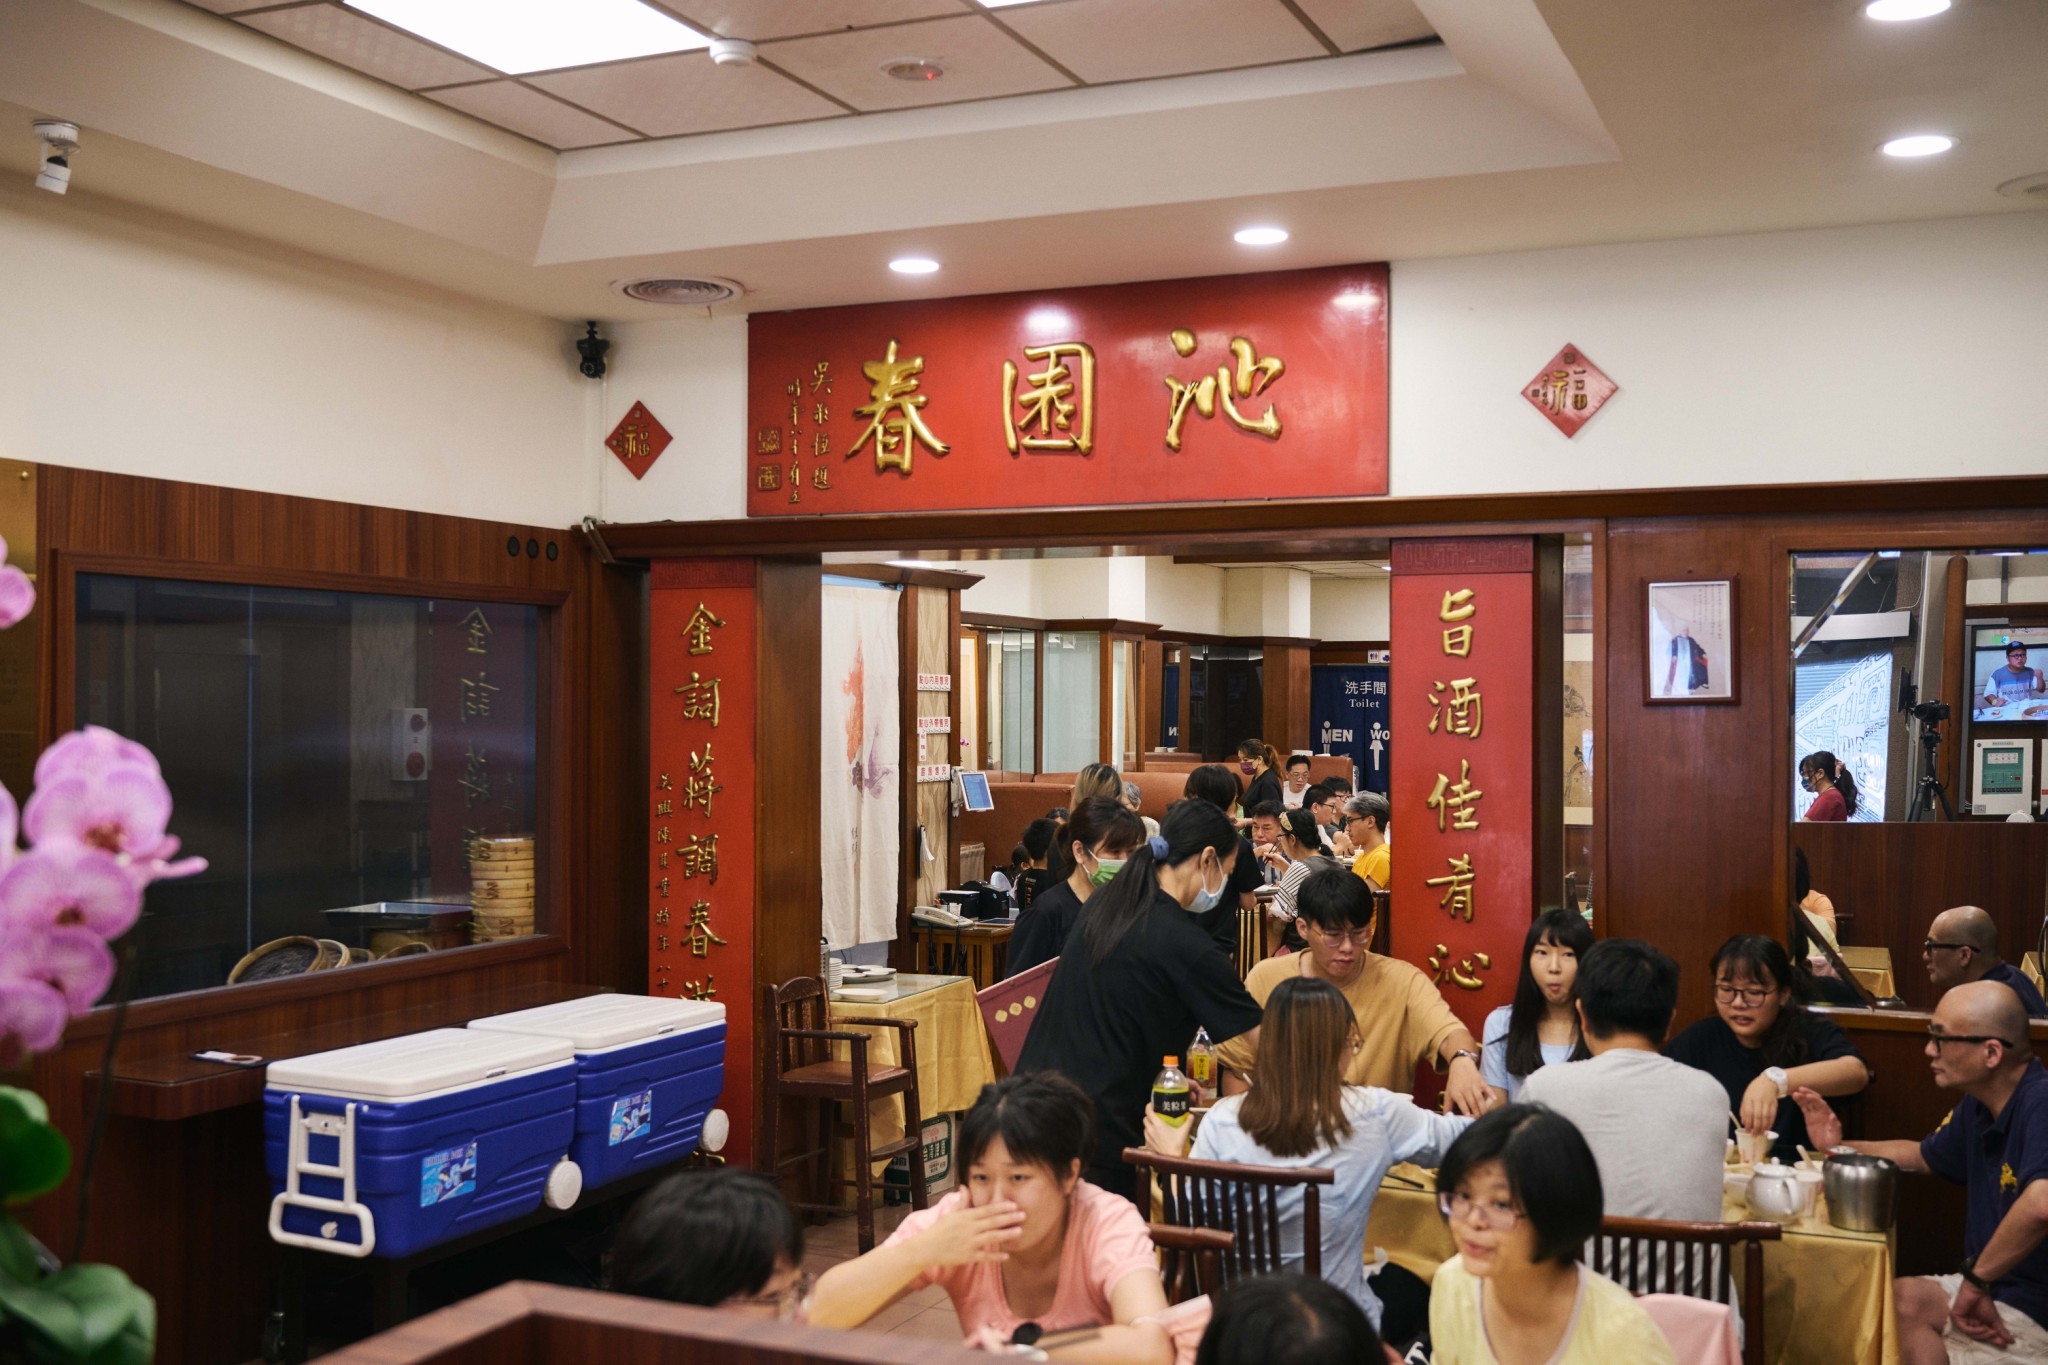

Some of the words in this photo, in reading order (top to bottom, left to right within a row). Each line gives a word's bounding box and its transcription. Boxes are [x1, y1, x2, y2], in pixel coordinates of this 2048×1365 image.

[844, 328, 1287, 475] 沁園春
[1549, 369, 1588, 416] 福
[624, 423, 650, 459] 福
[1345, 680, 1387, 695] 洗手間
[1348, 698, 1380, 708] Toilet
[1321, 728, 1353, 743] MEN
